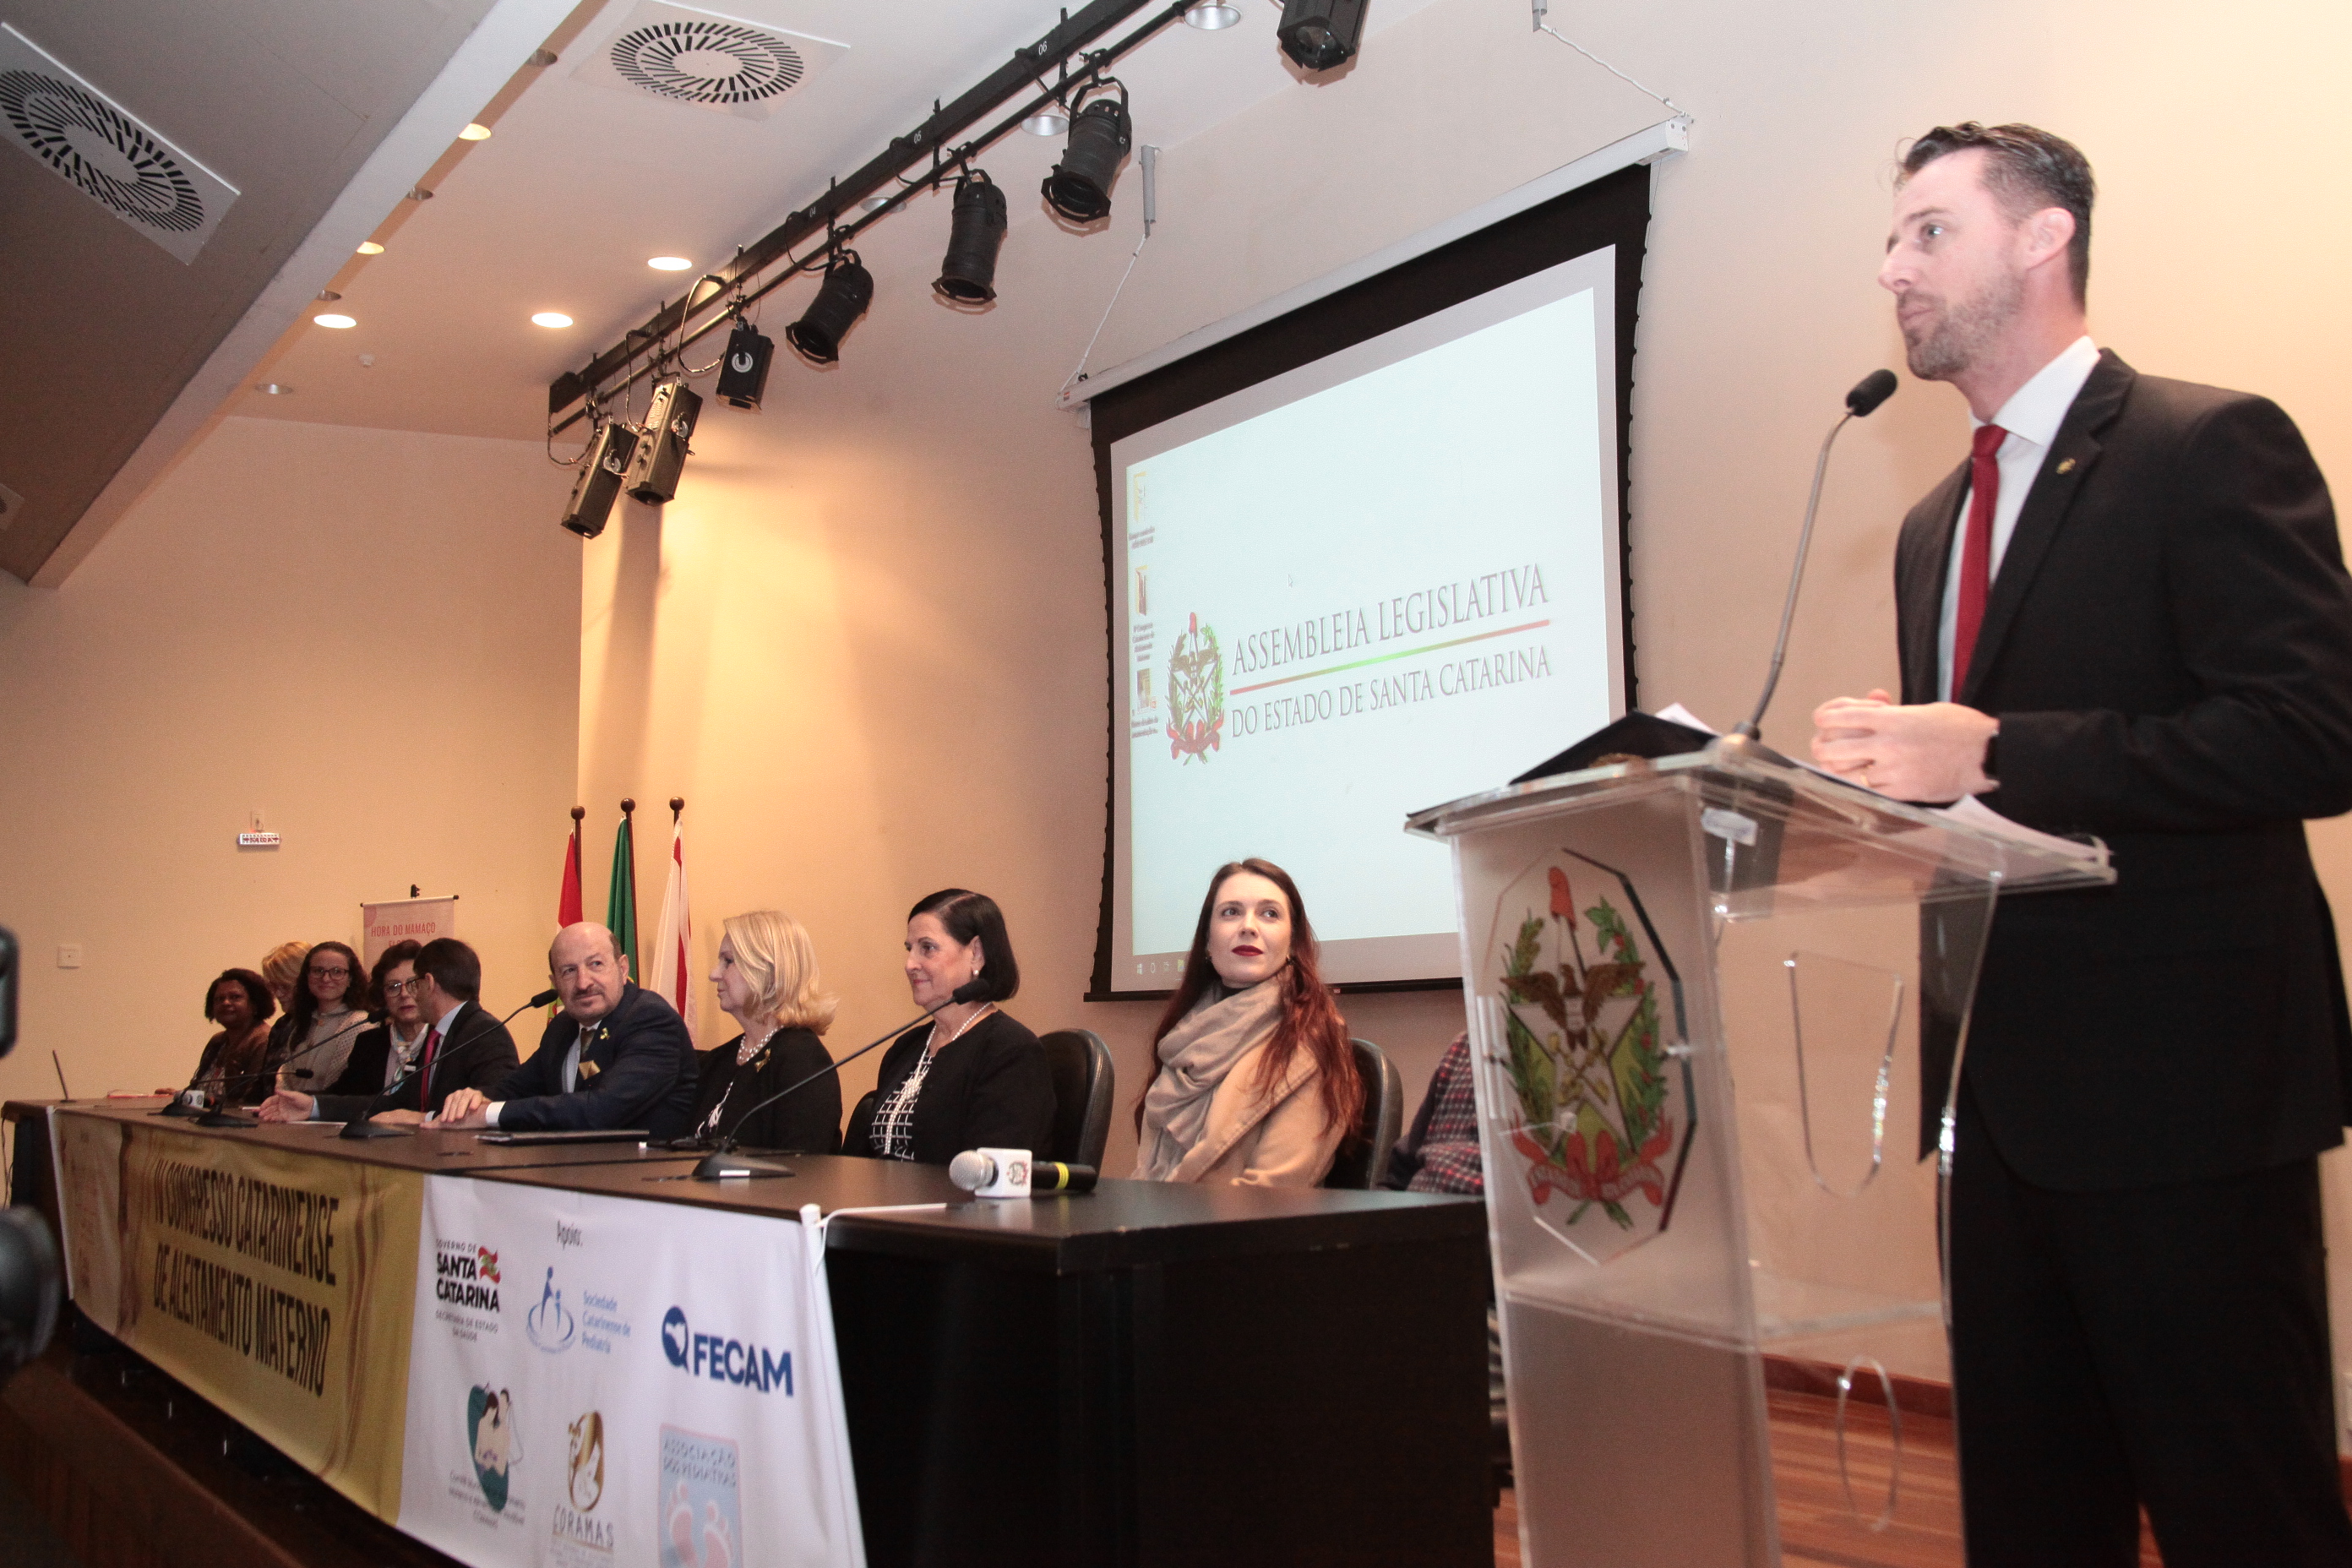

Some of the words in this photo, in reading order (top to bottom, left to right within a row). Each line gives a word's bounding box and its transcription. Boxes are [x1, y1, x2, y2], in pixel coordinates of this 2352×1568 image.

[1038, 41, 1048, 56] 06
[913, 130, 922, 144] 05
[1232, 607, 1370, 676] ASSEMBLEIA
[1378, 563, 1549, 641] LEGISLATIVA
[1232, 705, 1258, 738] DO
[1264, 689, 1332, 732] ESTADO
[1339, 683, 1364, 716] DE
[1369, 669, 1434, 710] SANTA
[1439, 645, 1552, 696] CATARINA
[371, 926, 390, 937] HORA
[393, 924, 403, 935] DO
[406, 922, 436, 936] MAMAÇO
[166, 1161, 234, 1249] CONGRESSO
[236, 1175, 339, 1286] CATARINENSE
[437, 1251, 476, 1281] SANTA
[154, 1242, 171, 1312] DE
[169, 1248, 253, 1357] ALEITAMENTO
[255, 1282, 330, 1397] MATERNO
[436, 1277, 500, 1313] CATARINA
[694, 1332, 793, 1396] FECAM
